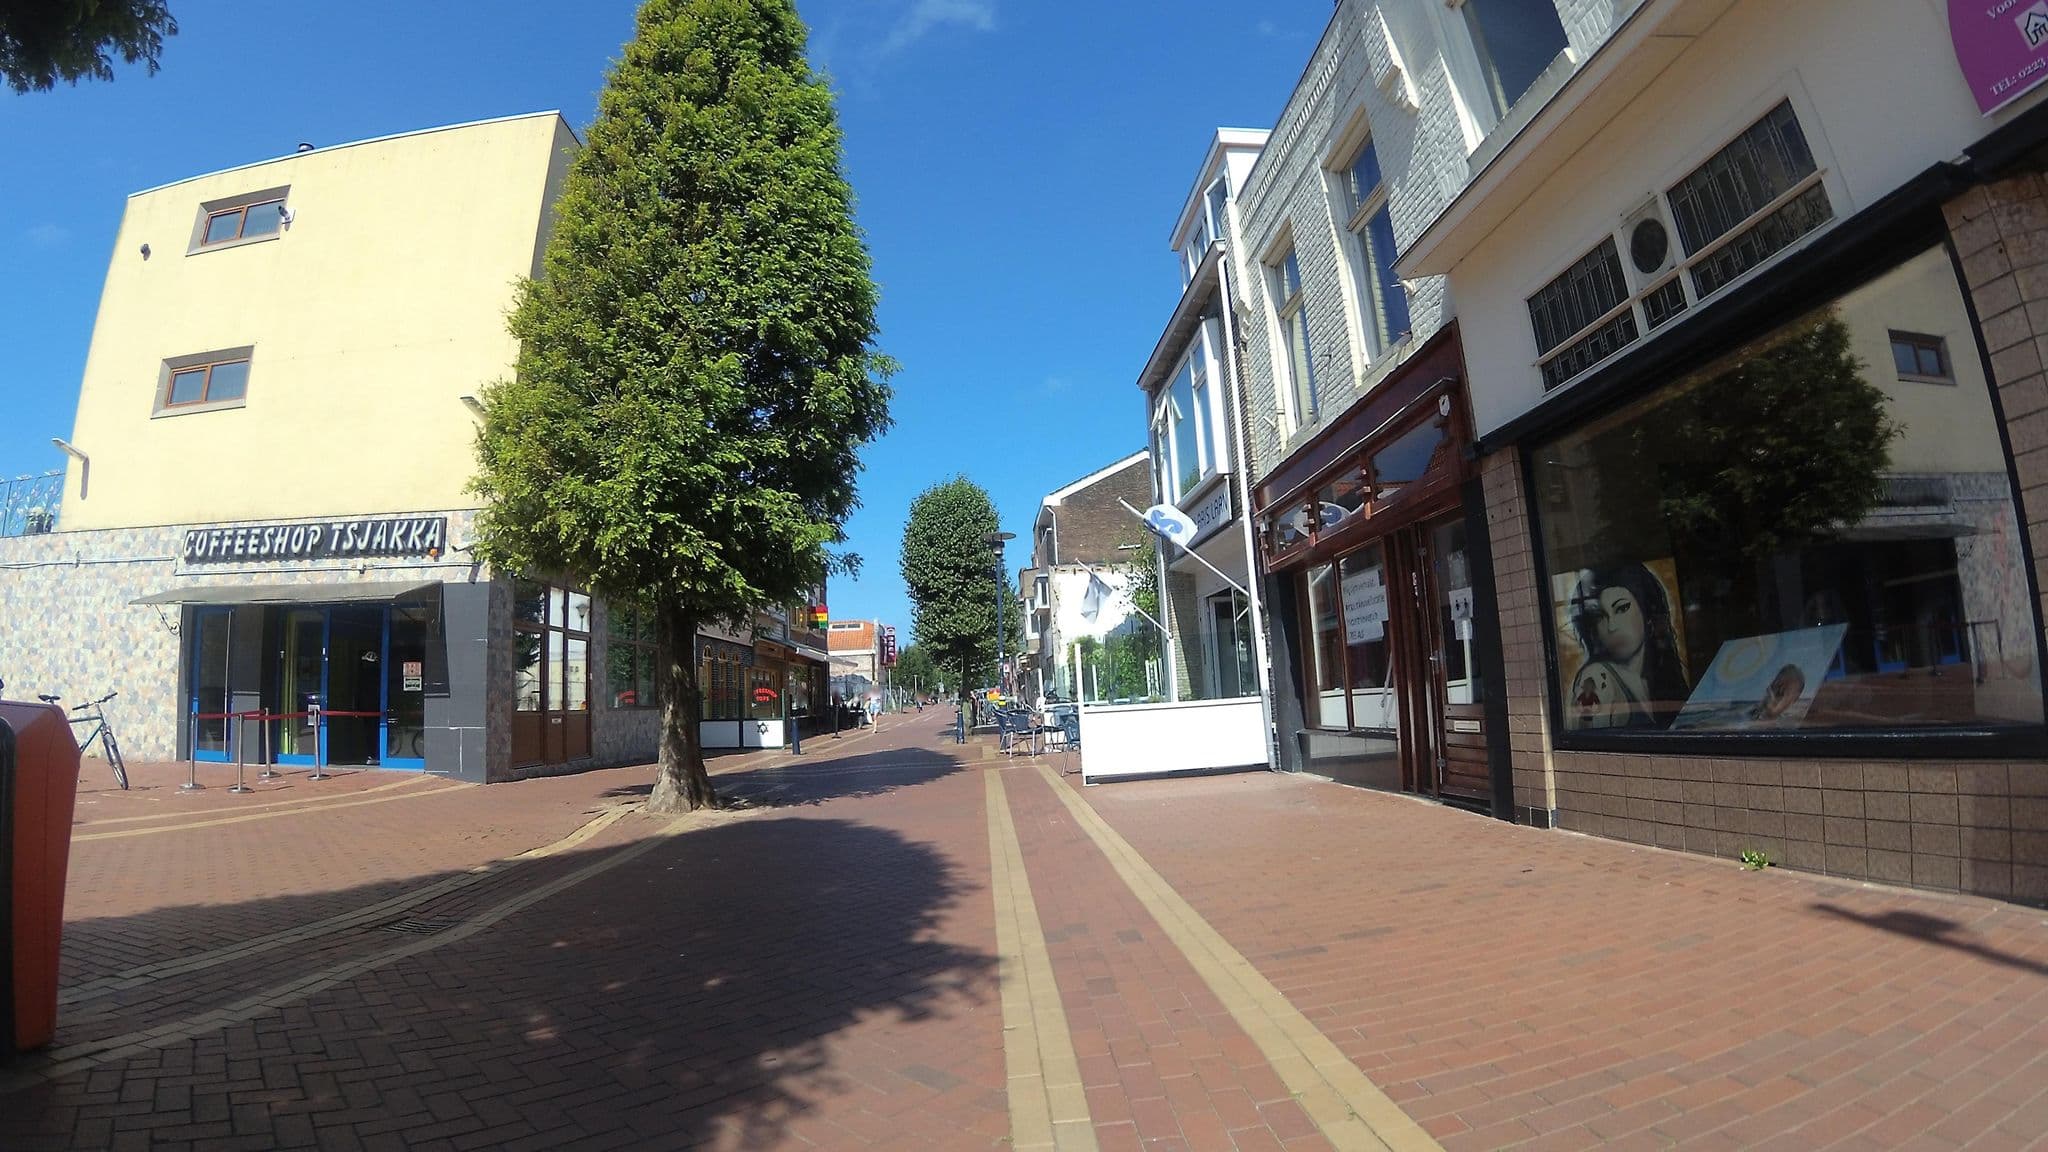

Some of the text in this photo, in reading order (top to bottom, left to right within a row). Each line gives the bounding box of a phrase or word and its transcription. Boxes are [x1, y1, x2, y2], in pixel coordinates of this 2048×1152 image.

[2018, 58, 2046, 79] 0223
[183, 519, 441, 557] COFFEESHOP TSJAKKA
